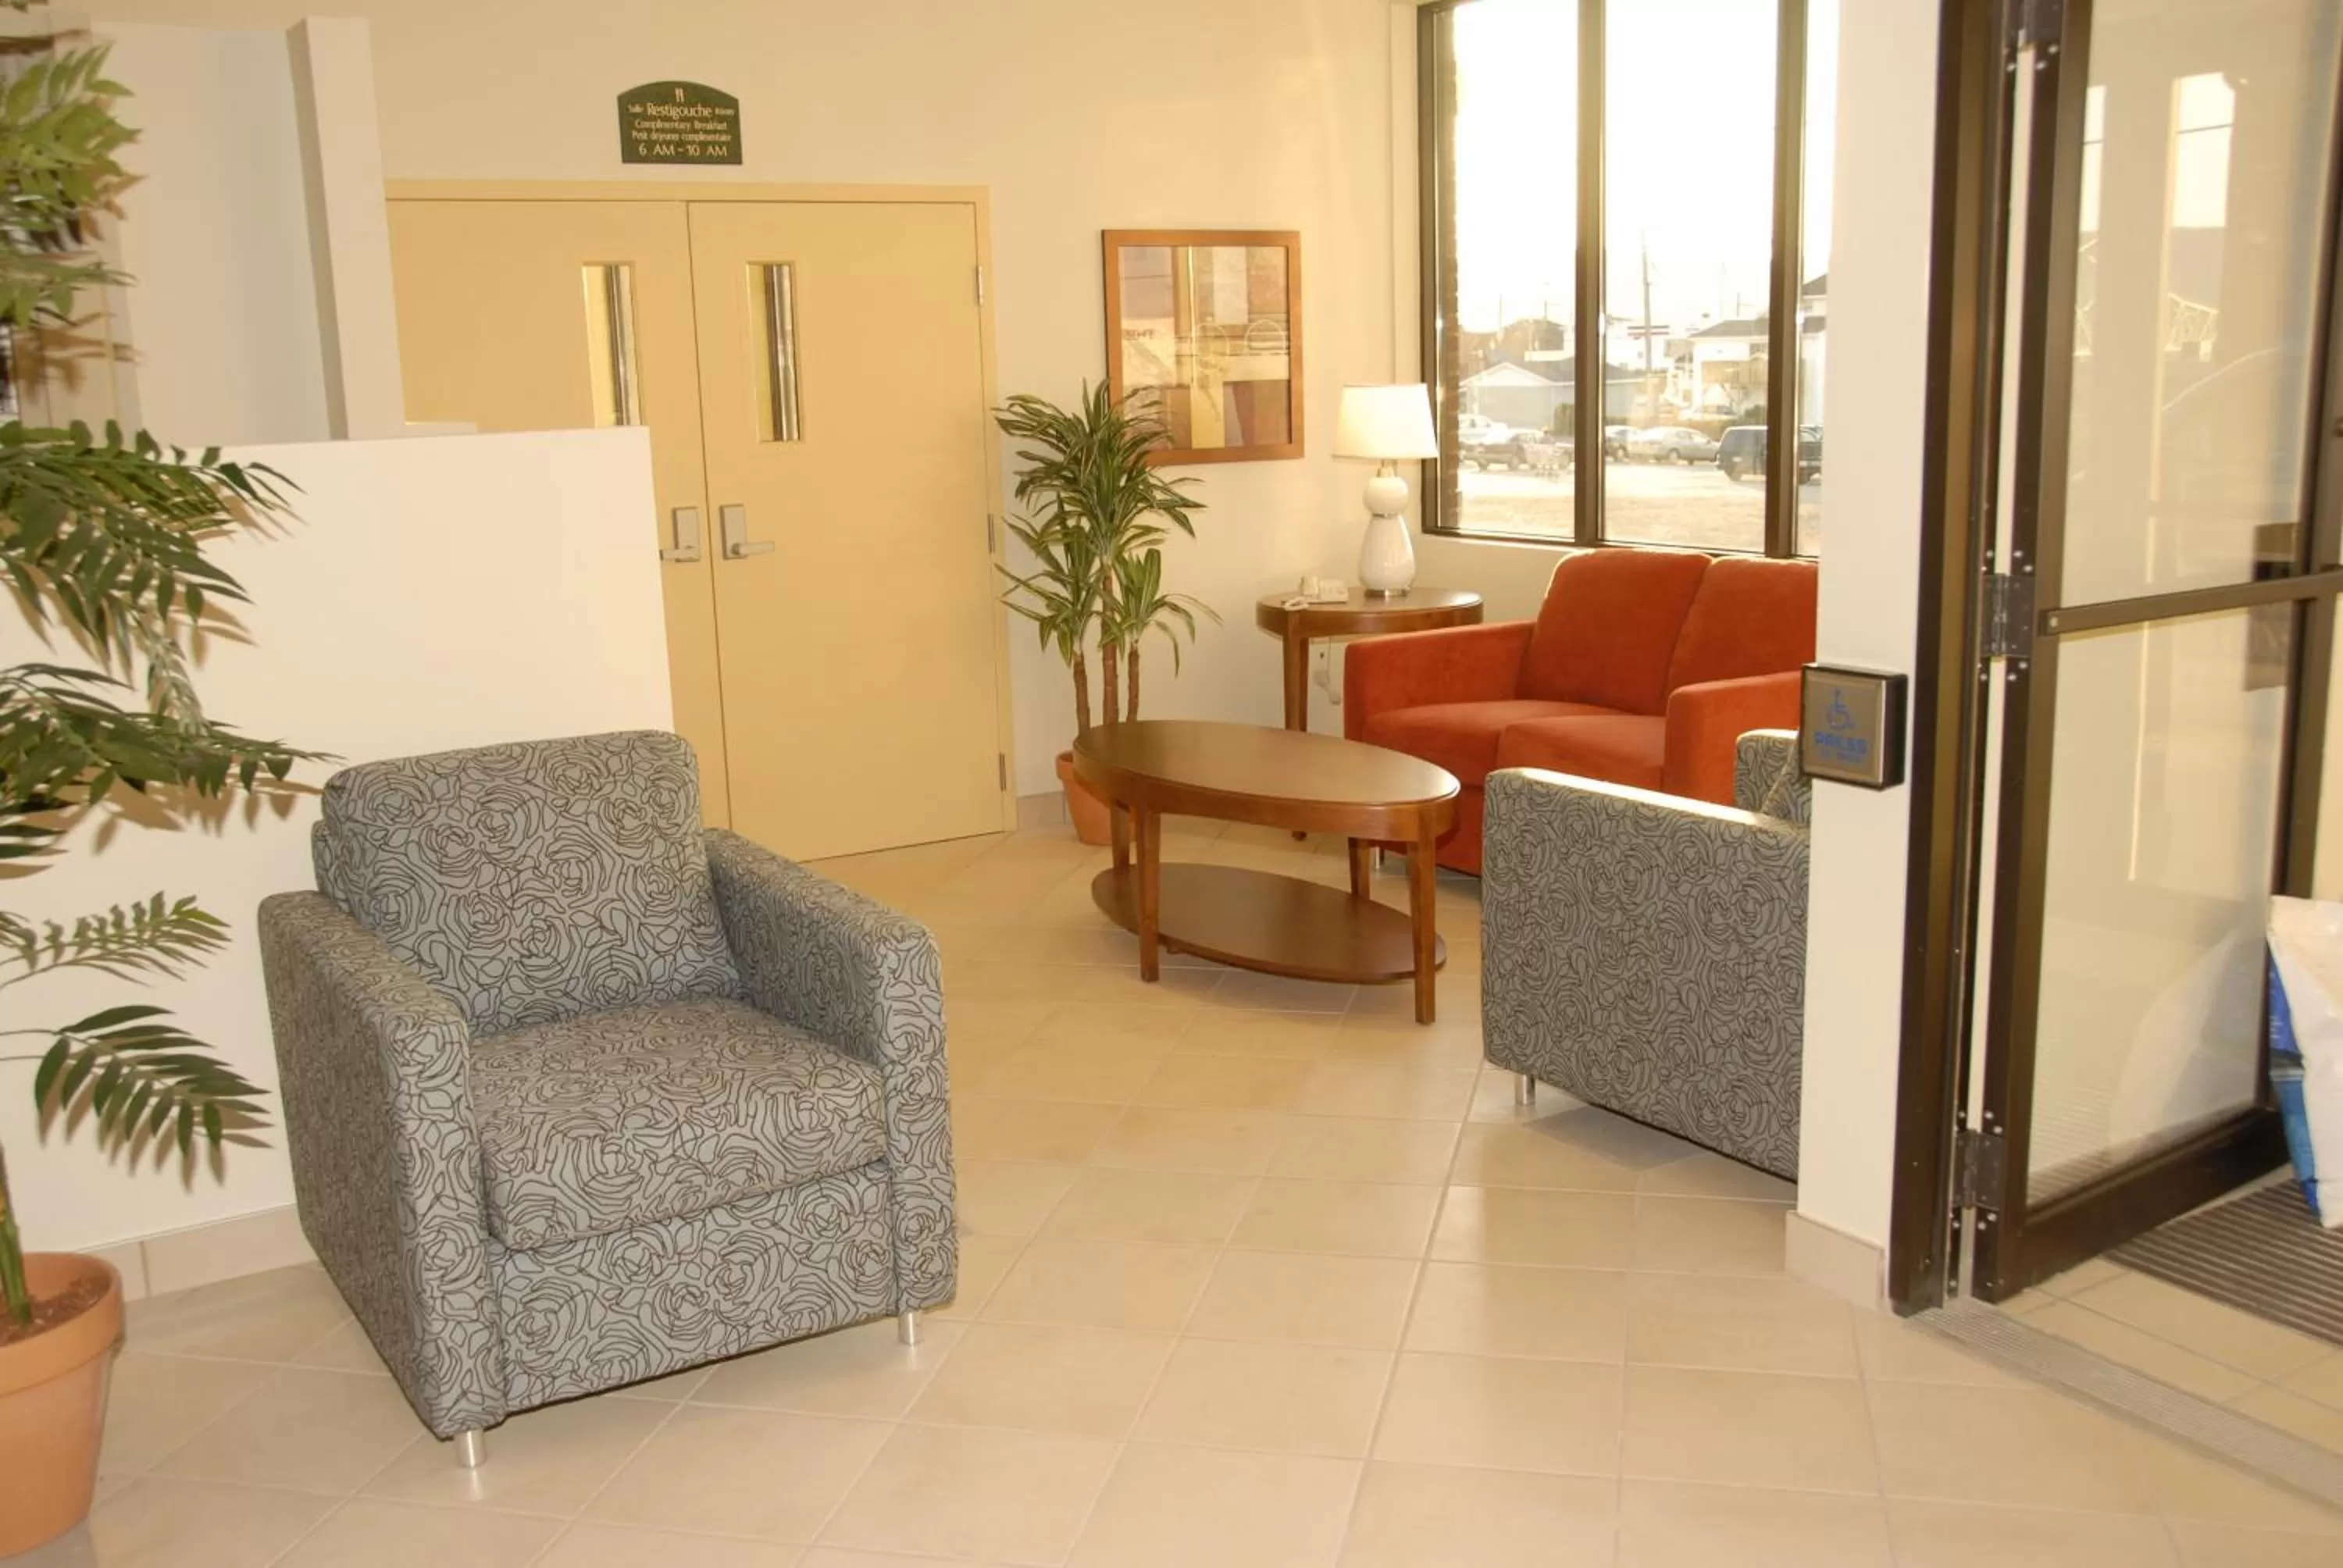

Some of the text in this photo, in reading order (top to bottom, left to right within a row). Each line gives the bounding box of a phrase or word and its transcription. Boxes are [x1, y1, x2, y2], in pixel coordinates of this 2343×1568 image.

[647, 102, 712, 119] Restigouche
[635, 119, 727, 132] Complimentary Breakfast
[638, 143, 647, 157] 6
[706, 145, 728, 157] AM
[1814, 731, 1867, 754] PRESS
